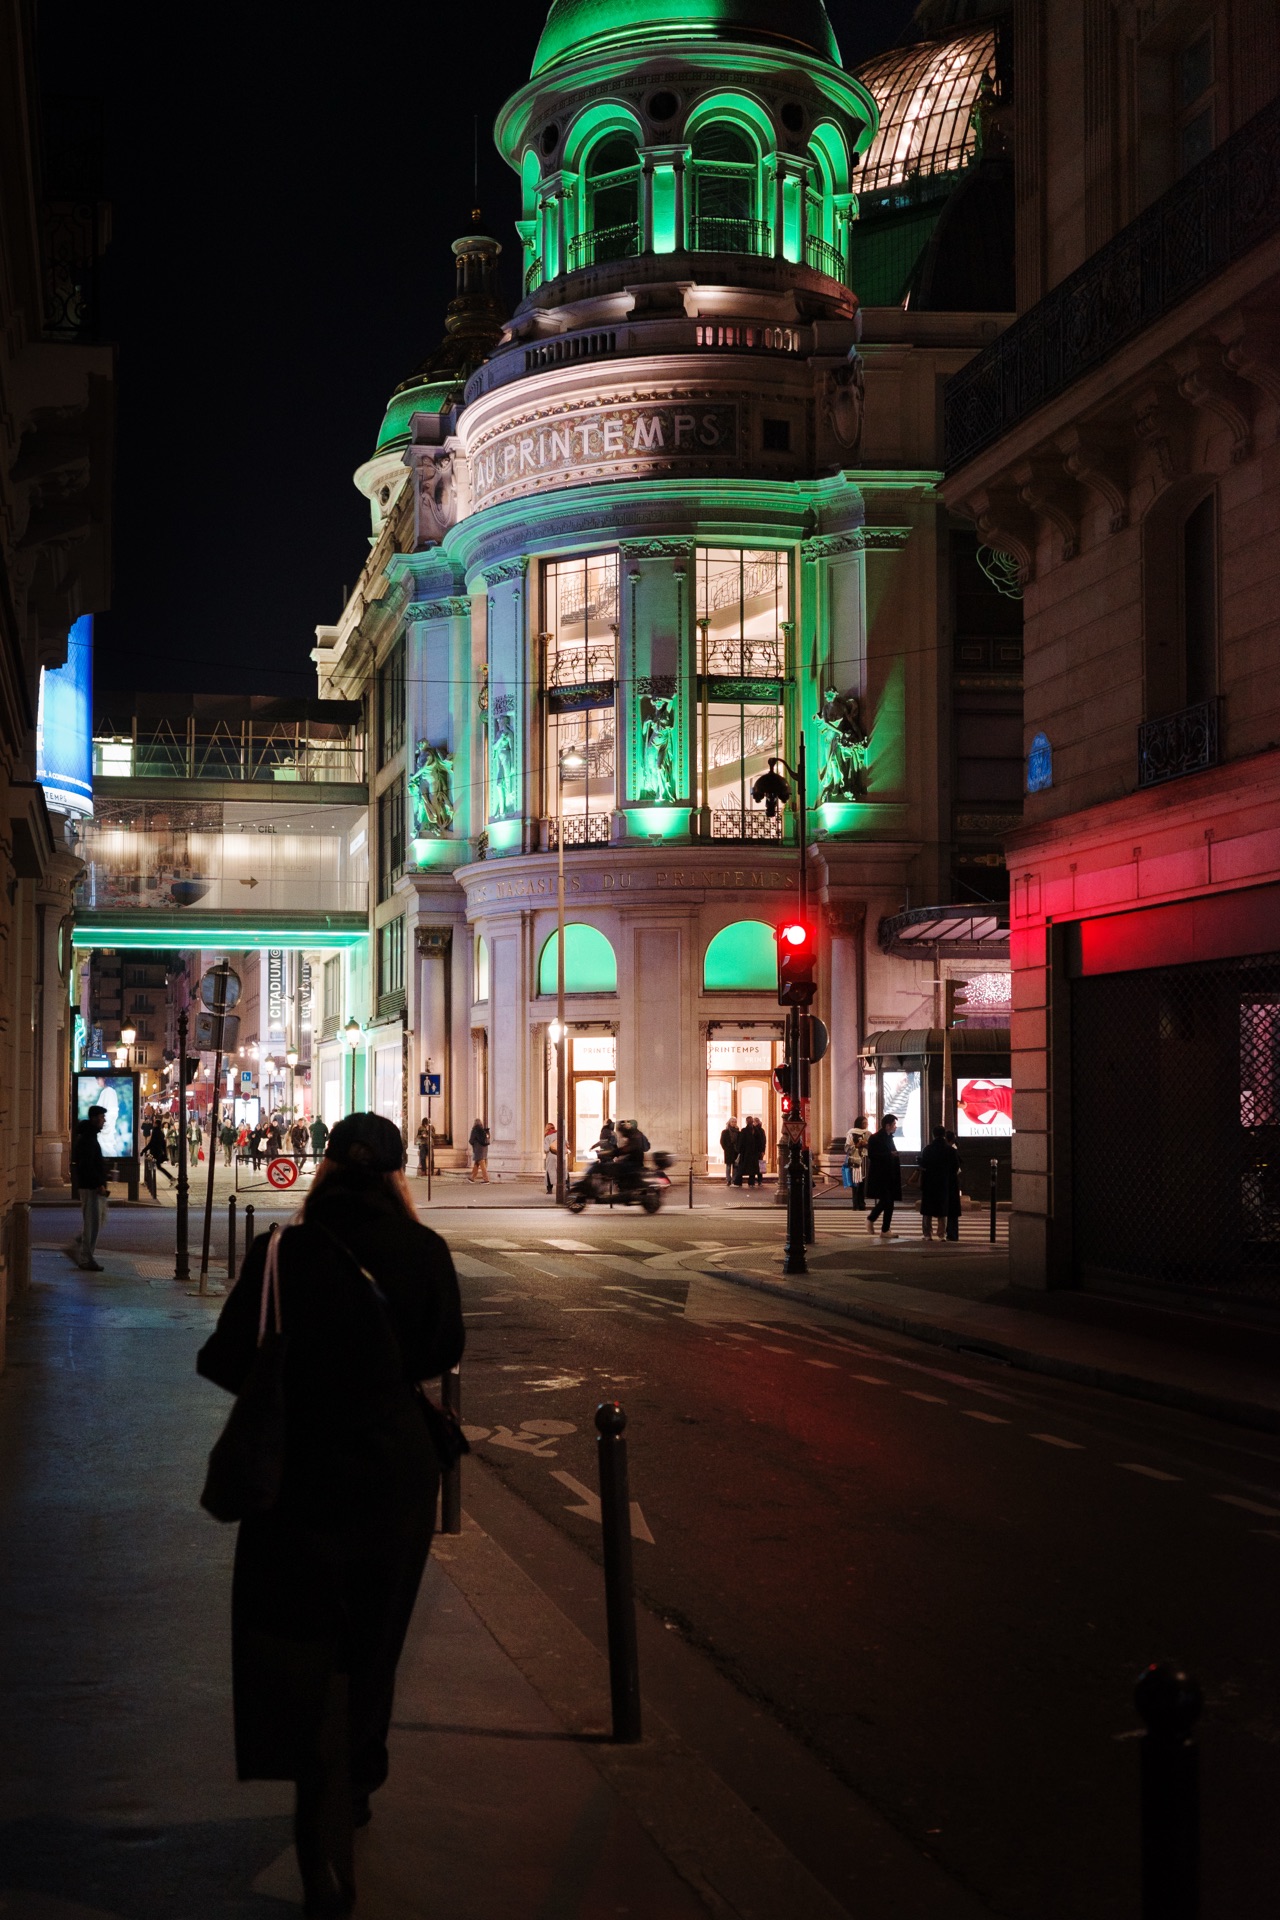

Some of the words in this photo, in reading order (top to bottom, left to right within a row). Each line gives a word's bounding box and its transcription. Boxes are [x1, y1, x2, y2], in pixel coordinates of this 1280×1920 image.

[477, 457, 496, 491] AU
[503, 413, 721, 476] PRINTEMPS
[258, 825, 278, 834] CIEL
[602, 873, 631, 890] DU
[656, 871, 794, 889] PRINTEMPS
[709, 1046, 760, 1054] PRINTEMPS
